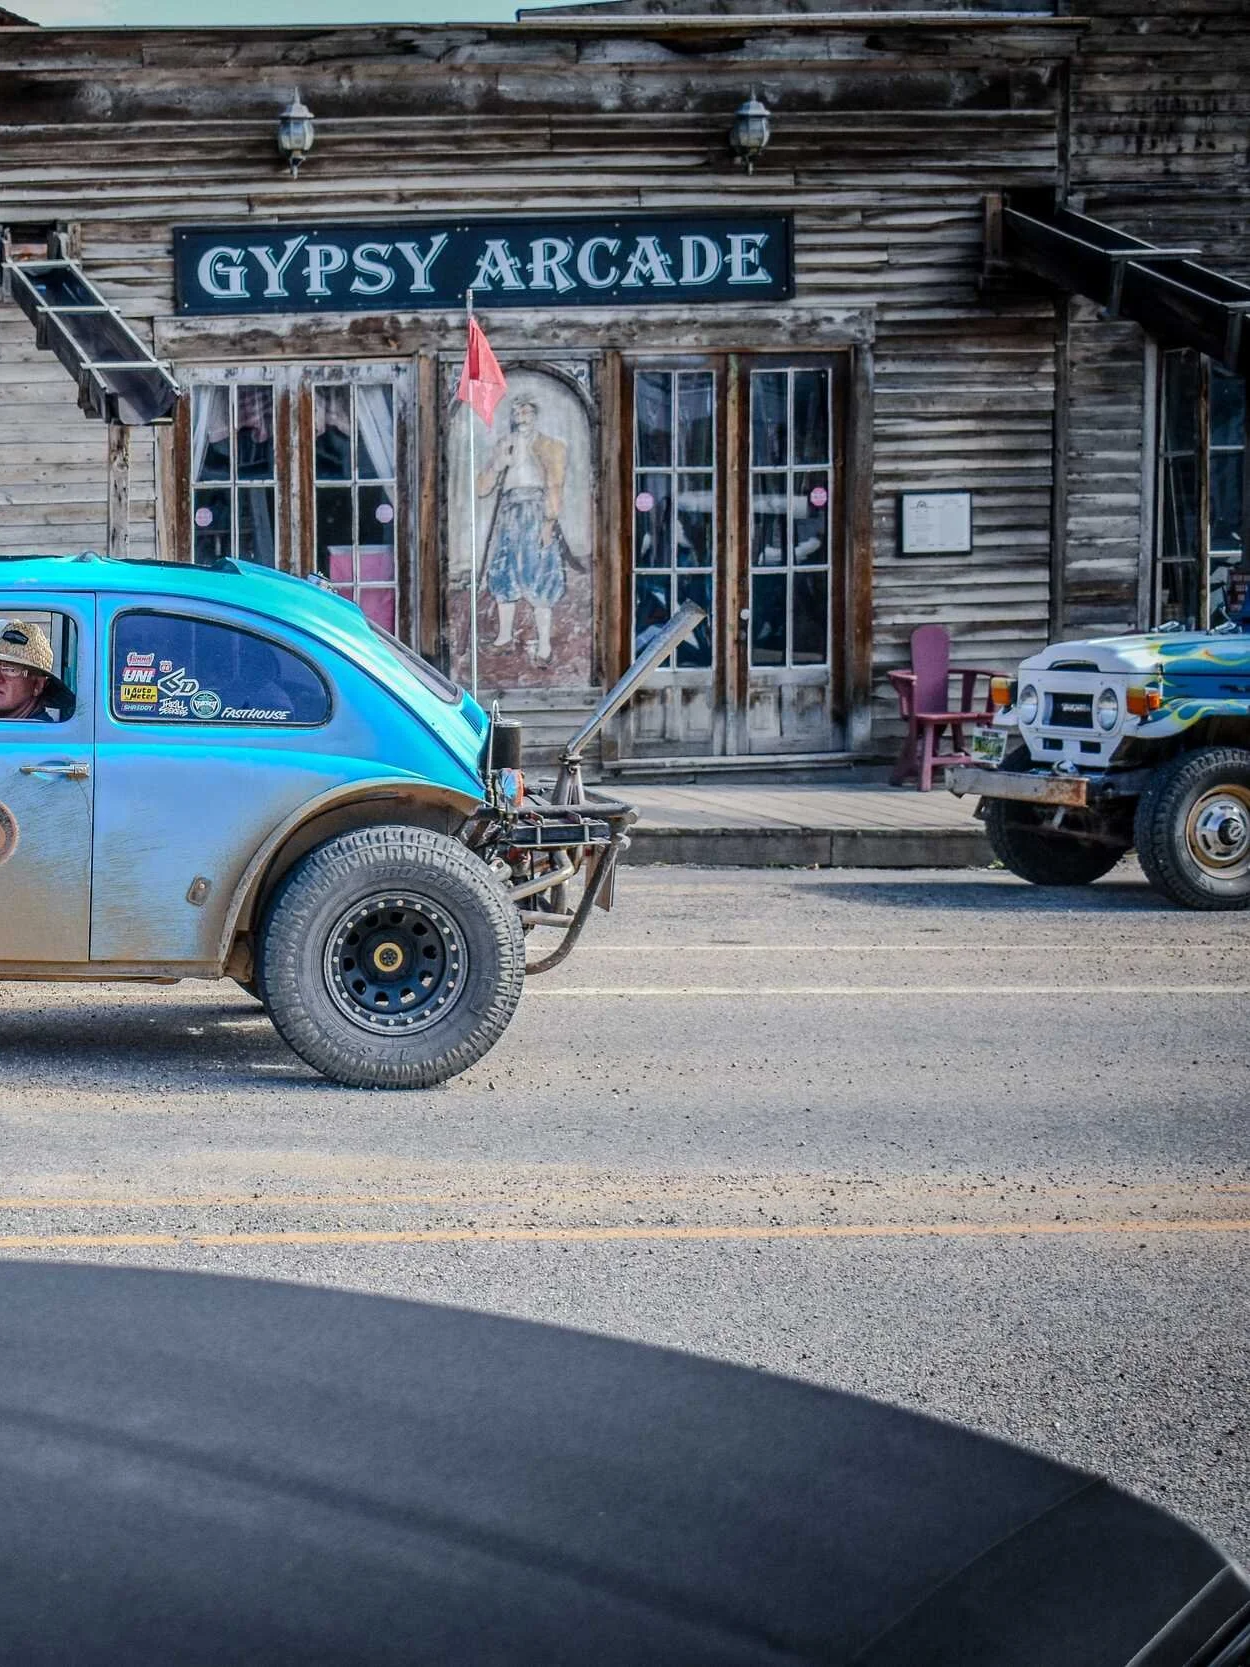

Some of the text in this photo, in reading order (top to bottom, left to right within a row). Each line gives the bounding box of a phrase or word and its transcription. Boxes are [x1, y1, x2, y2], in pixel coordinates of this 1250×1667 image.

[197, 232, 773, 298] GYPSY ARCADE
[221, 707, 290, 720] FASTHOUSE
